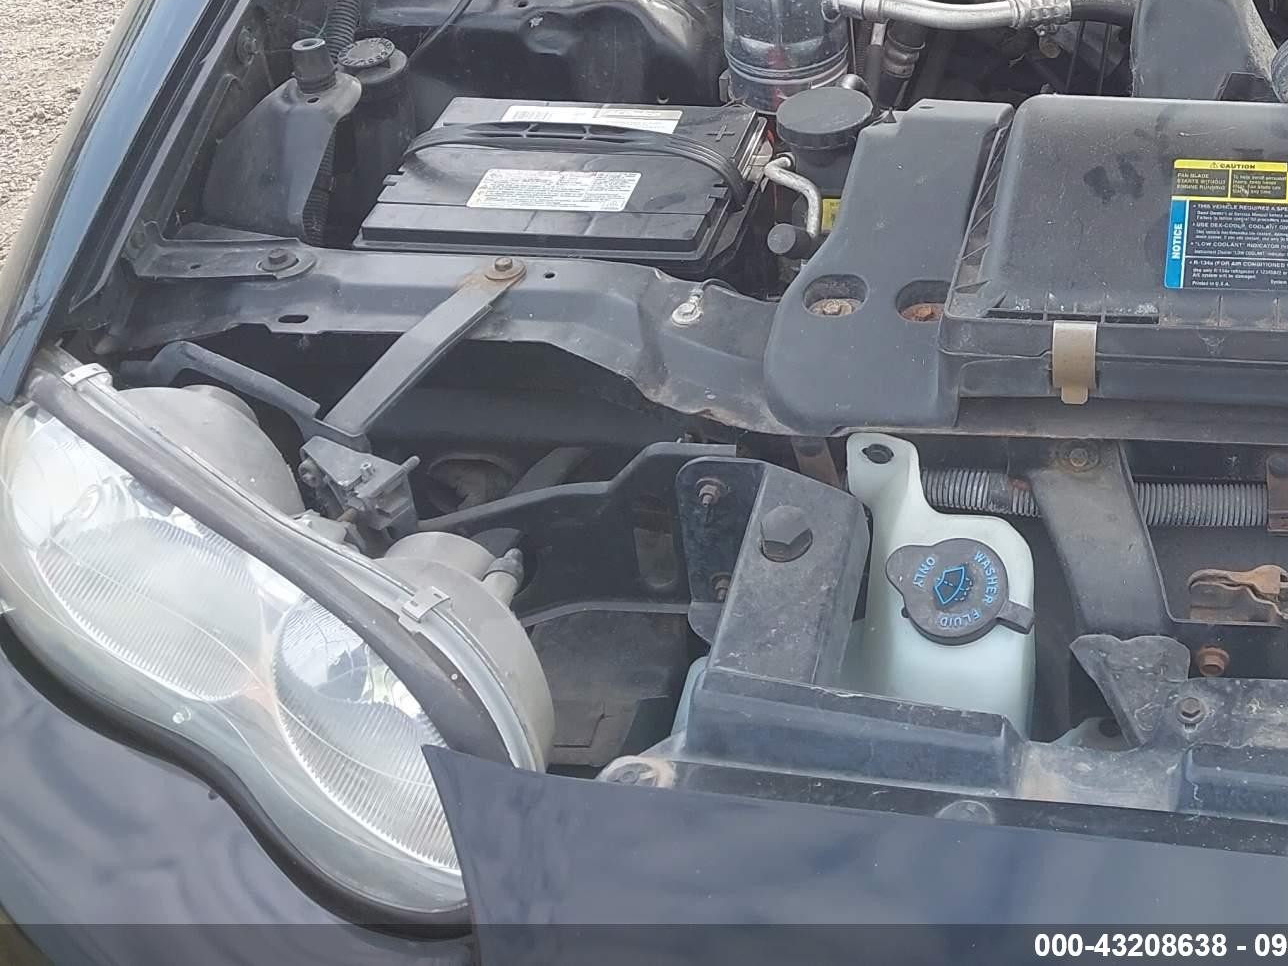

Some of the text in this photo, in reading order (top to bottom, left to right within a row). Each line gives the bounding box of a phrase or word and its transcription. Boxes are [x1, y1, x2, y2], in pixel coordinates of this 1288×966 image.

[1172, 223, 1182, 259] NOTICE
[913, 551, 998, 627] WASHER FLUID ONLY
